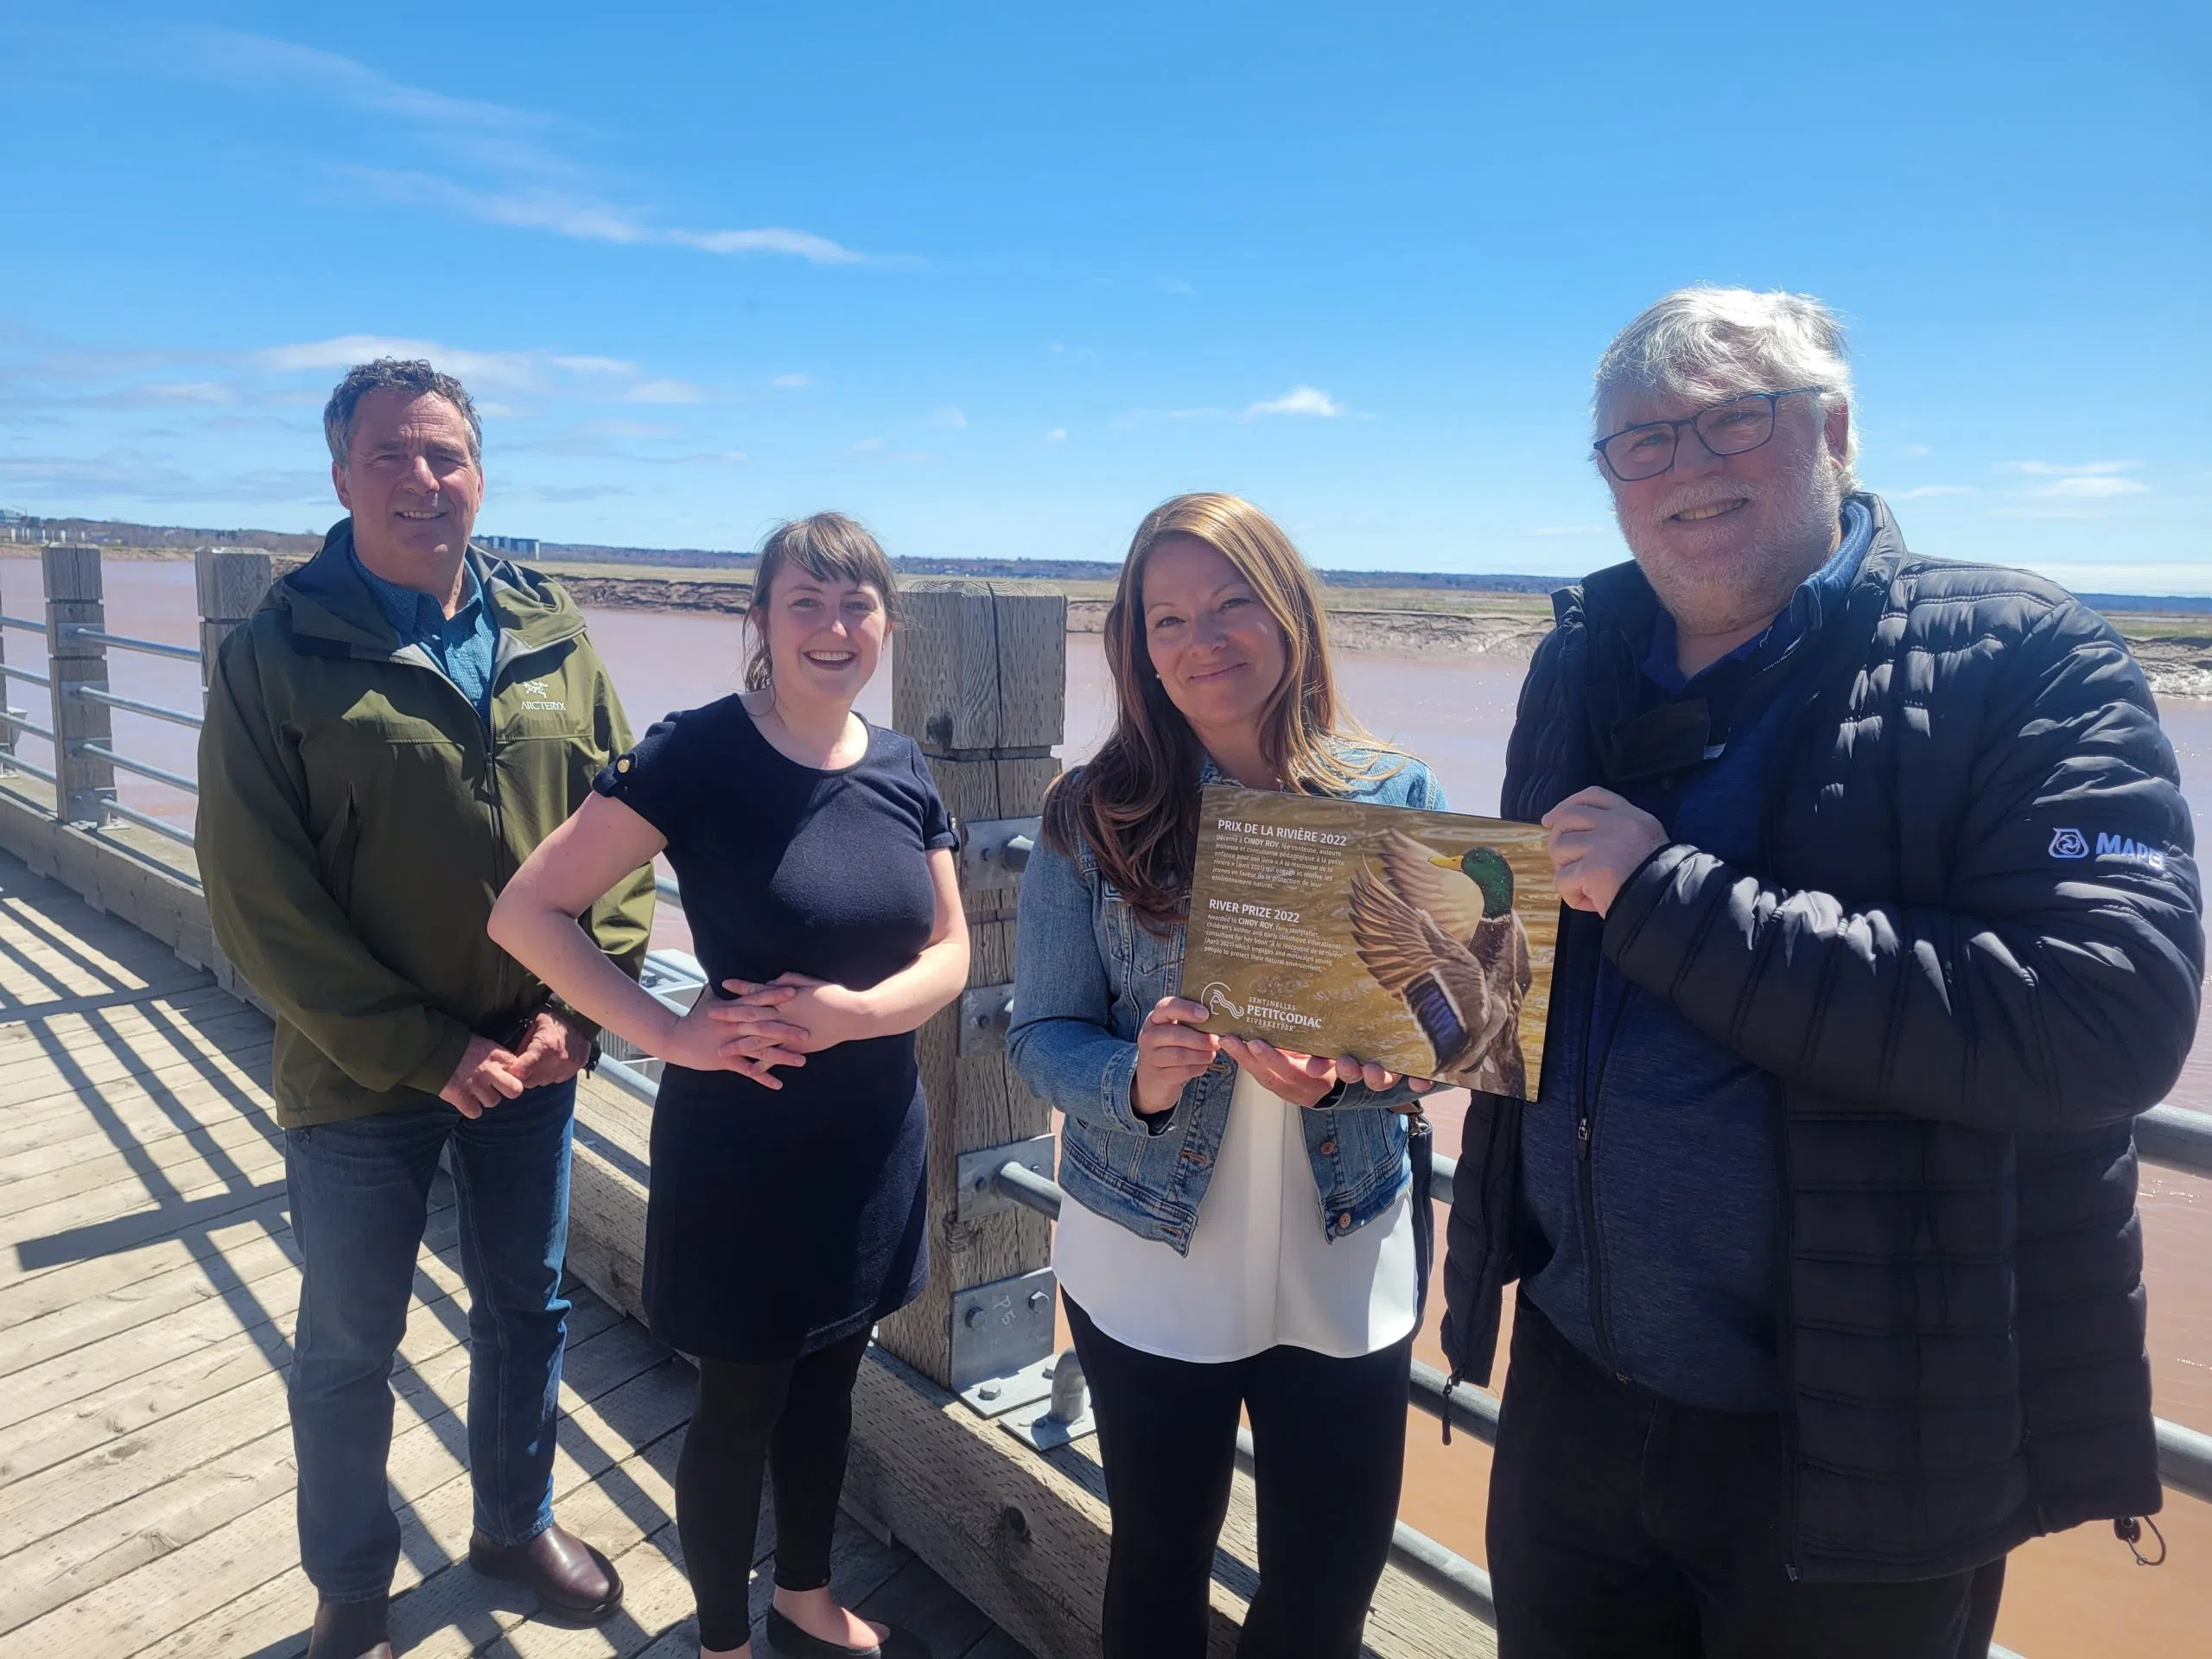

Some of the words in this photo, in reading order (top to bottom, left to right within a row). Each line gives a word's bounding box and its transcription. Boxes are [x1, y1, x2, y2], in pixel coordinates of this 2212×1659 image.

[1218, 820, 1243, 832] PRIX
[1245, 823, 1258, 835] DE
[1262, 825, 1274, 836] LA
[1277, 828, 1318, 842] RIVIÈRE
[1320, 833, 1347, 847] 2022
[1244, 837, 1264, 846] CINDY
[1210, 899, 1239, 913] RIVER
[1242, 904, 1272, 918] PRIZE
[1274, 910, 1300, 924] 2022
[1238, 918, 1258, 928] CINDY
[1249, 995, 1296, 1013] SENTINELLES
[1247, 1003, 1322, 1031] PETITCODIAC
